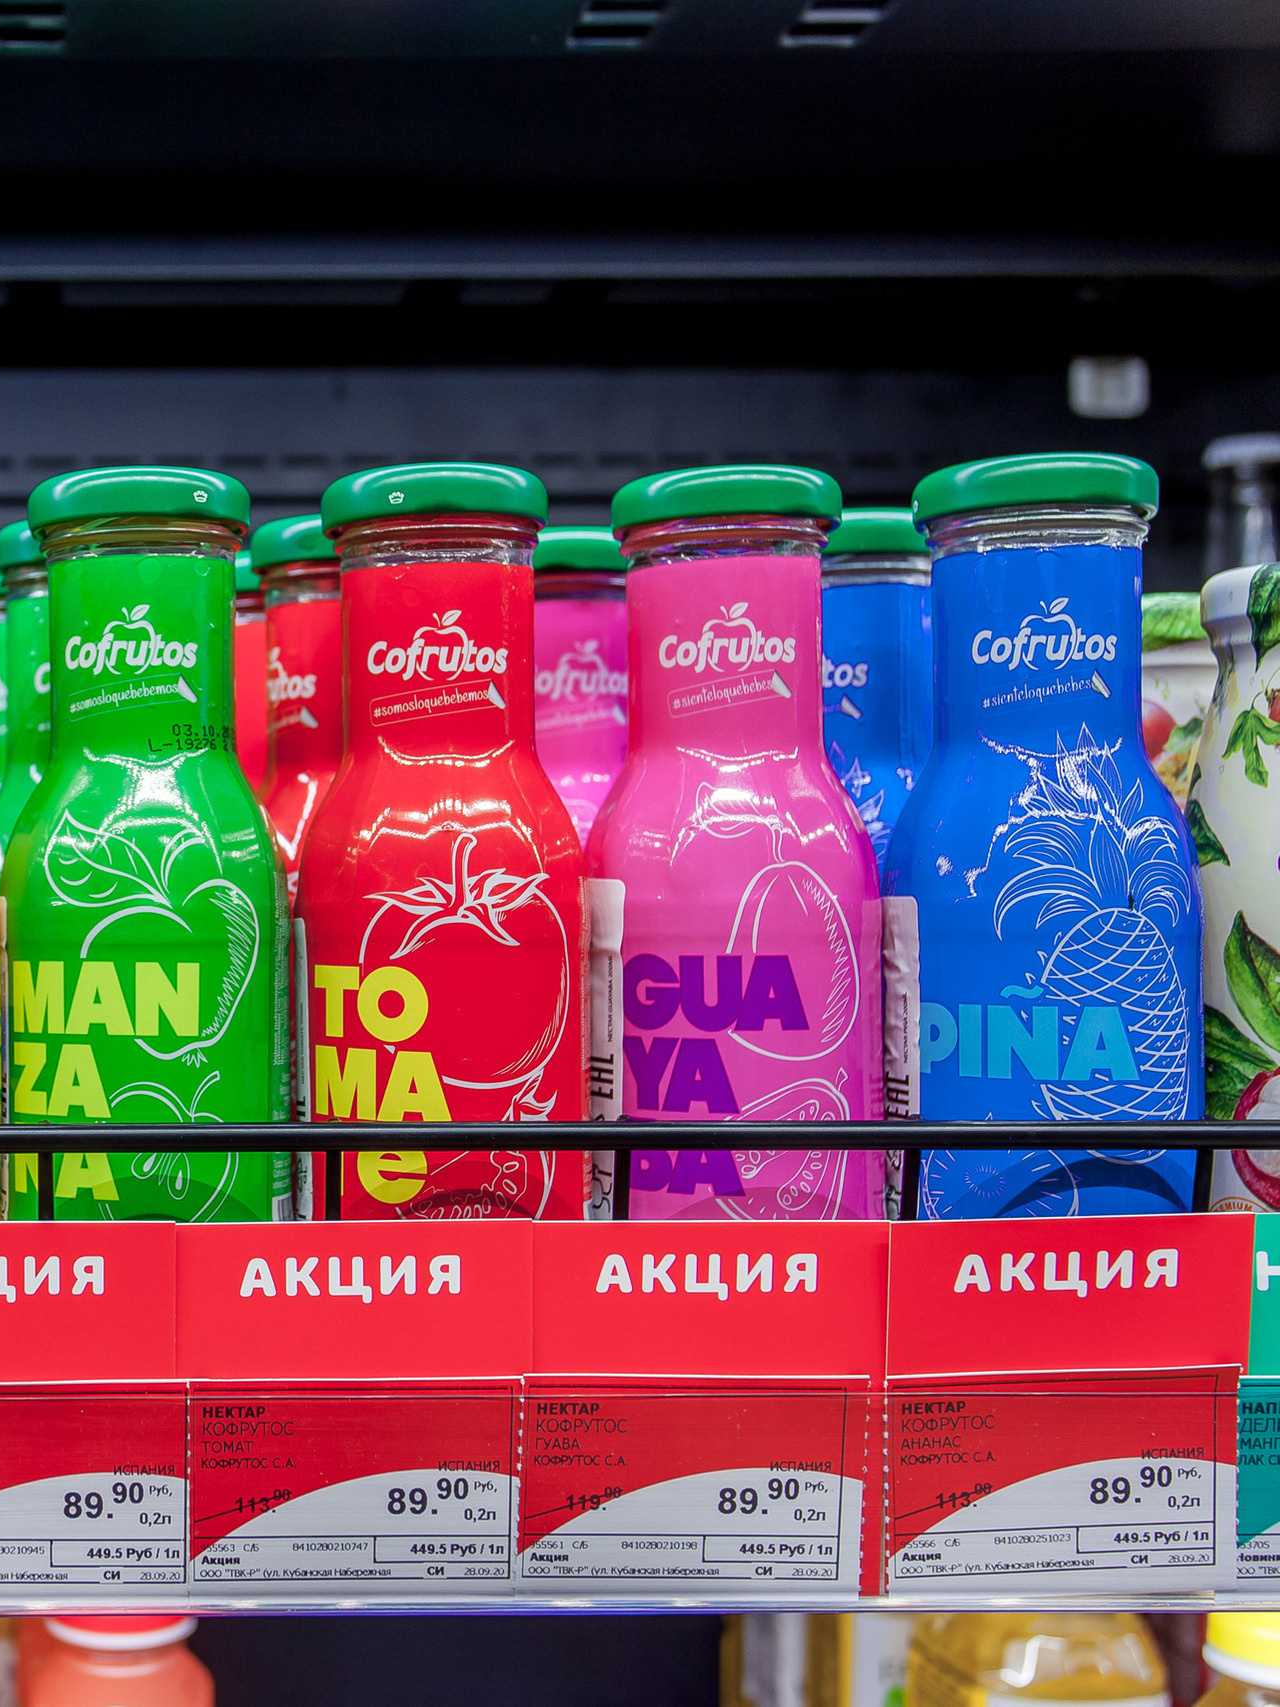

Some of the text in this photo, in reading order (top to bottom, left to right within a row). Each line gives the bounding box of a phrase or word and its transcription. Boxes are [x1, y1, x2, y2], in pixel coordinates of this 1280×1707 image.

[65, 633, 198, 675] Cofrutos
[659, 630, 796, 673] Cofrutos
[972, 627, 1117, 670] Cofrutos
[367, 638, 508, 681] Cofrutos
[70, 681, 178, 714] #somosloquebebemos
[673, 675, 772, 709] #sienteloquebebes
[982, 675, 1092, 709] #sienteloquebebes
[373, 688, 488, 718] #somosloquebebemos
[13, 961, 200, 1036] MAN
[623, 954, 809, 1032] GUA
[314, 964, 429, 1042] TO
[920, 984, 1140, 1081] PIÑA
[13, 1043, 111, 1118] ZA
[315, 1045, 452, 1121] MA
[623, 1036, 740, 1114] YA
[239, 1254, 462, 1303] АКЦИЯ
[594, 1253, 819, 1301] АКЦИЯ
[953, 1247, 1180, 1298] АКЦИЯ
[202, 1406, 266, 1418] НЕКТАР
[537, 1403, 600, 1415] НЕКТАР
[901, 1401, 966, 1415] НЕКТАР
[202, 1421, 295, 1437] КОФРУТОС
[536, 1418, 628, 1434] КОФРУТОС
[901, 1415, 995, 1433] КОФРУТОС
[201, 1441, 255, 1454] ТОМАТ
[536, 1438, 580, 1450] ГУАВА
[901, 1436, 962, 1450] АНАНАС
[1141, 1447, 1205, 1460] ИСПАНИЯ
[113, 1465, 176, 1476] ИСПАНИЯ
[201, 1458, 297, 1469] КОФРУТОС С.А.
[438, 1460, 501, 1472] ИСПАНИЯ
[770, 1461, 832, 1472] ИСПАНИЯ
[139, 1512, 171, 1525] 0,2л
[464, 1508, 496, 1522] 0,2л
[86, 1548, 123, 1559] 449.5
[292, 1542, 368, 1552] 8410280210747
[410, 1543, 447, 1555] 449.5
[450, 1543, 477, 1558] Руб
[490, 1544, 504, 1555] 1л
[201, 1555, 241, 1566] Акция
[901, 1552, 942, 1562] Акция
[200, 1569, 222, 1578] ООО
[283, 1567, 333, 1578] Кубанская
[334, 1567, 392, 1577] Набережная
[427, 1566, 505, 1576] СИ 28.09.20
